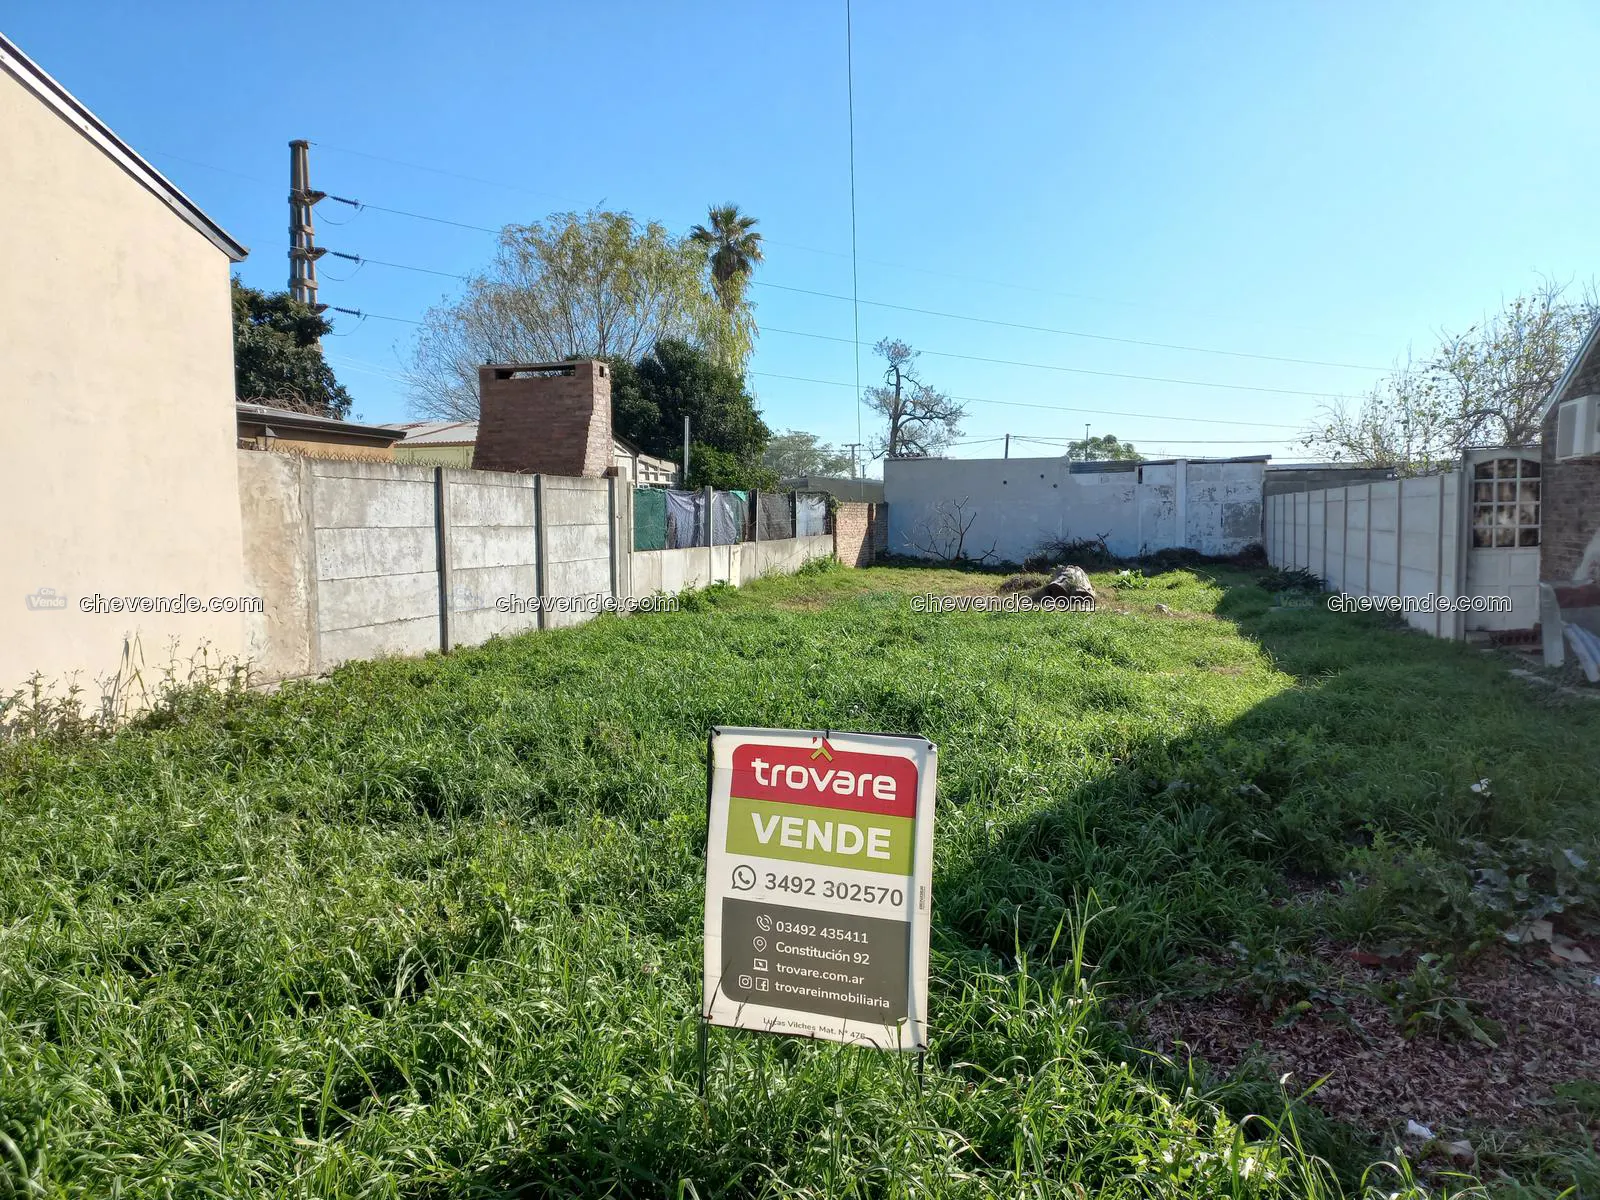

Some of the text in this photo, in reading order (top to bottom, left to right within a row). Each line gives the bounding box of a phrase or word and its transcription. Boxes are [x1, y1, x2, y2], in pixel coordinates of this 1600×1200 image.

[751, 758, 897, 801] trovare
[751, 812, 892, 860] VENDE
[764, 873, 816, 896] 3492
[823, 880, 904, 907] 302570
[776, 921, 869, 944] 03492 435411
[775, 941, 870, 965] Constitución 92
[775, 962, 865, 985] trovare.com.ar
[774, 981, 890, 1009] trovareinmobiliaria
[787, 1020, 816, 1031] Vilches
[819, 1025, 836, 1035] Mat.
